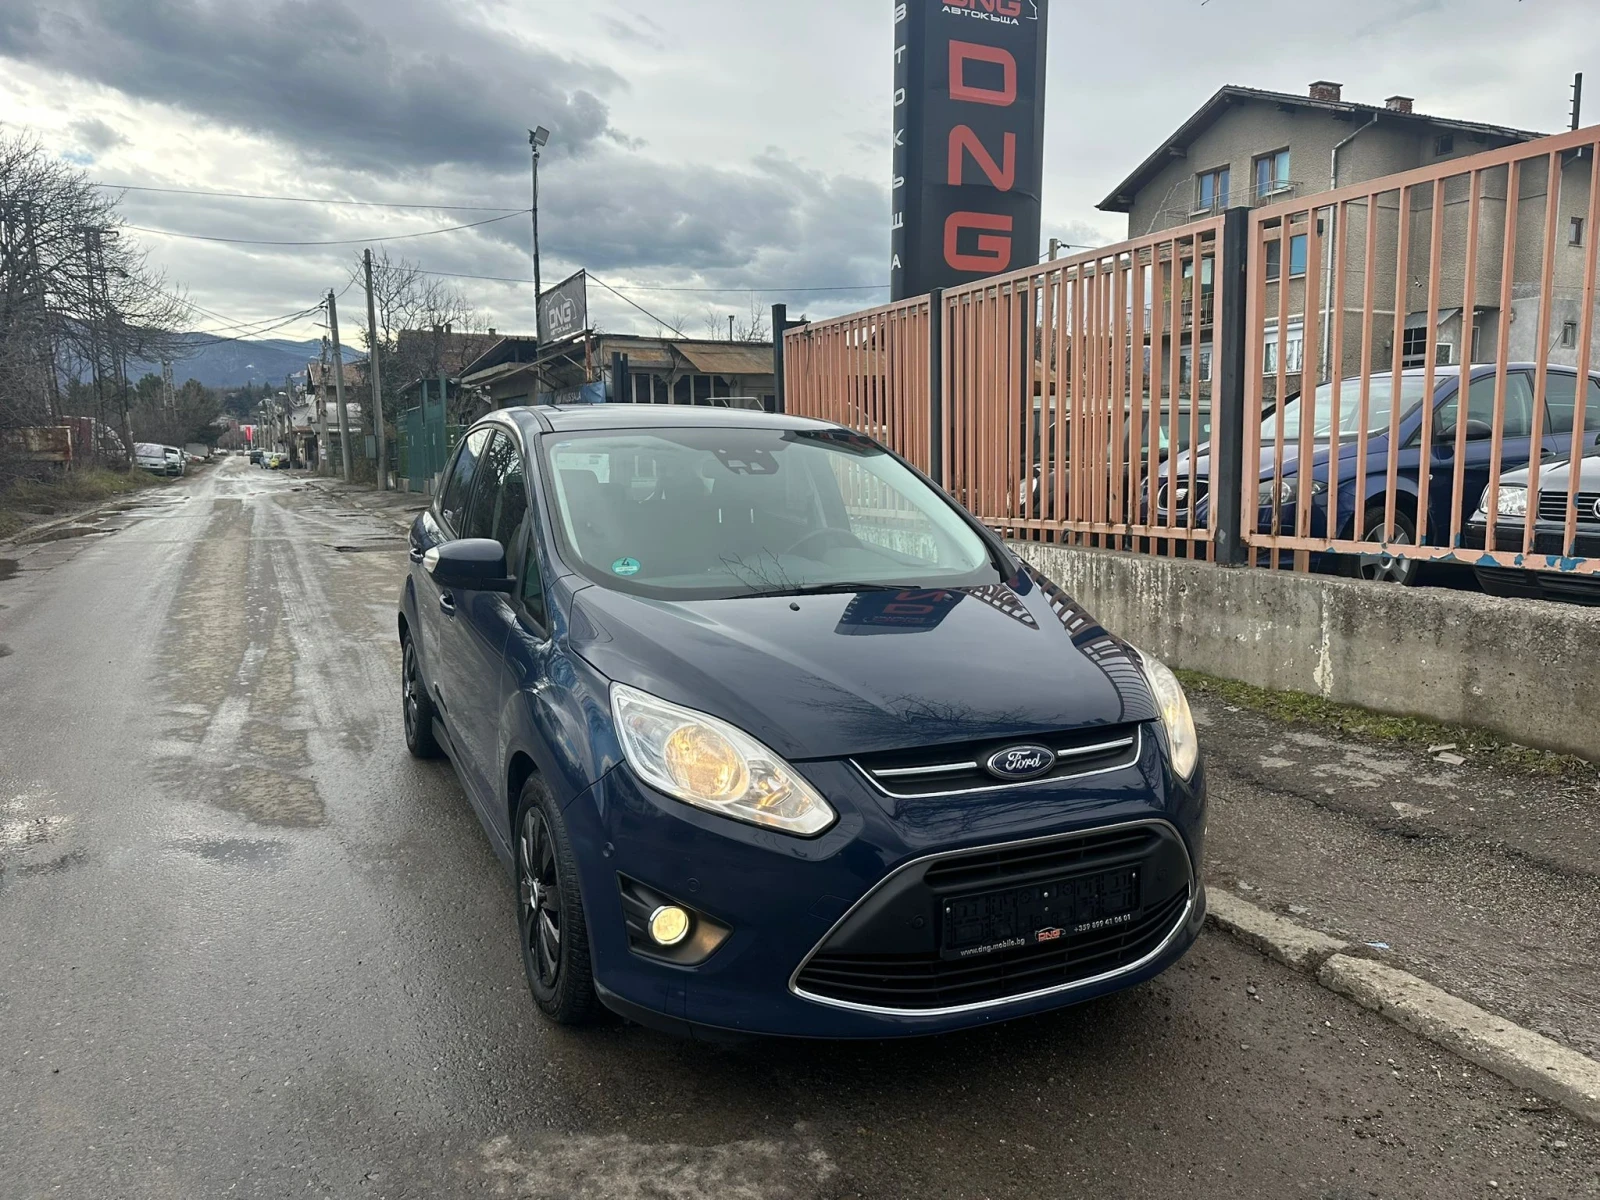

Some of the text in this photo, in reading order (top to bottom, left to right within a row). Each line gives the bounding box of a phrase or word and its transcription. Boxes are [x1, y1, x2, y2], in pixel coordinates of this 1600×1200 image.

[944, 39, 1018, 273] DNG
[549, 301, 571, 329] DNG
[621, 558, 630, 566] 4
[1006, 750, 1042, 771] Ford
[959, 937, 1026, 957] www.dng.mobile.bg
[1073, 922, 1091, 933] +359
